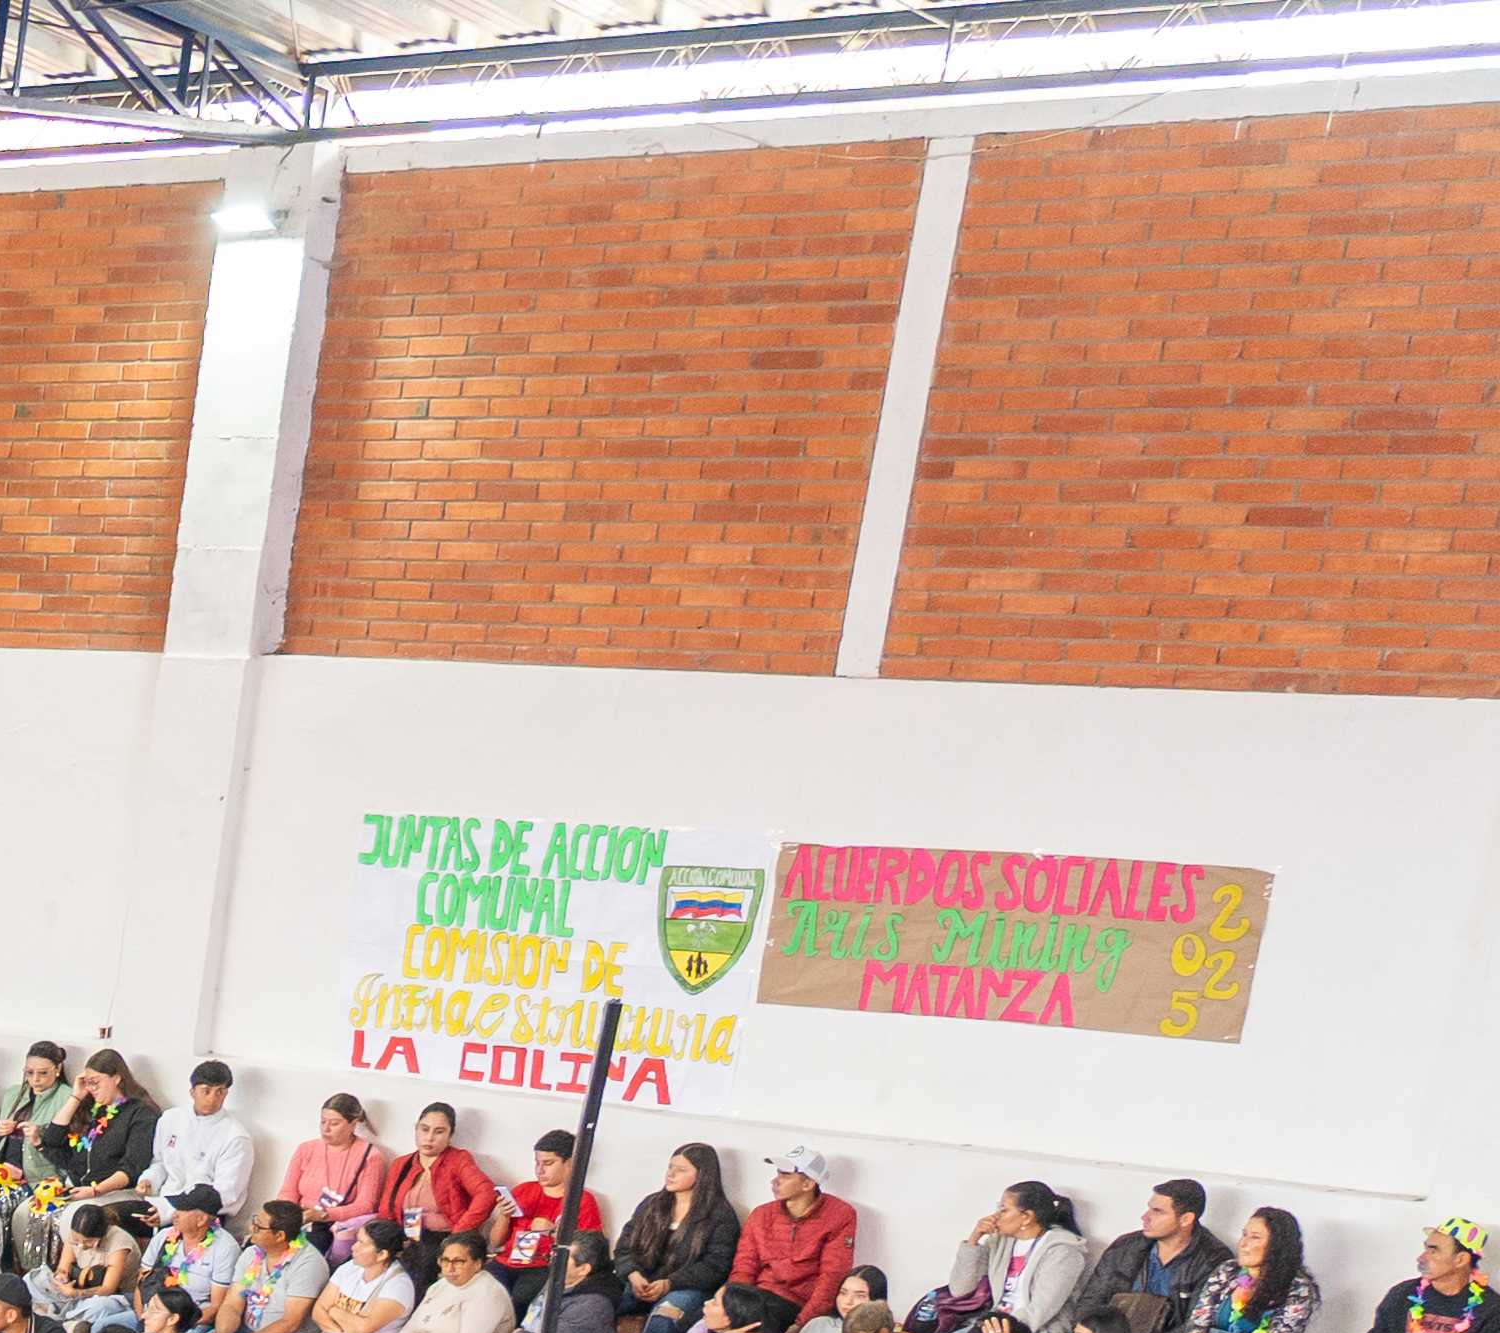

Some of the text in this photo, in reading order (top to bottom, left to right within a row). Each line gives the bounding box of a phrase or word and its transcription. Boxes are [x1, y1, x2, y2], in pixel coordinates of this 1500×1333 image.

[358, 813, 482, 872] JUNTAS
[499, 818, 534, 875] DE
[414, 871, 575, 938] COMUNAL
[781, 843, 1206, 923] ACUERDOS SOCIALES
[581, 939, 629, 998] DE
[781, 898, 1133, 994] Aris Mining
[858, 959, 1075, 1028] MATANZA
[350, 1030, 421, 1074] LA
